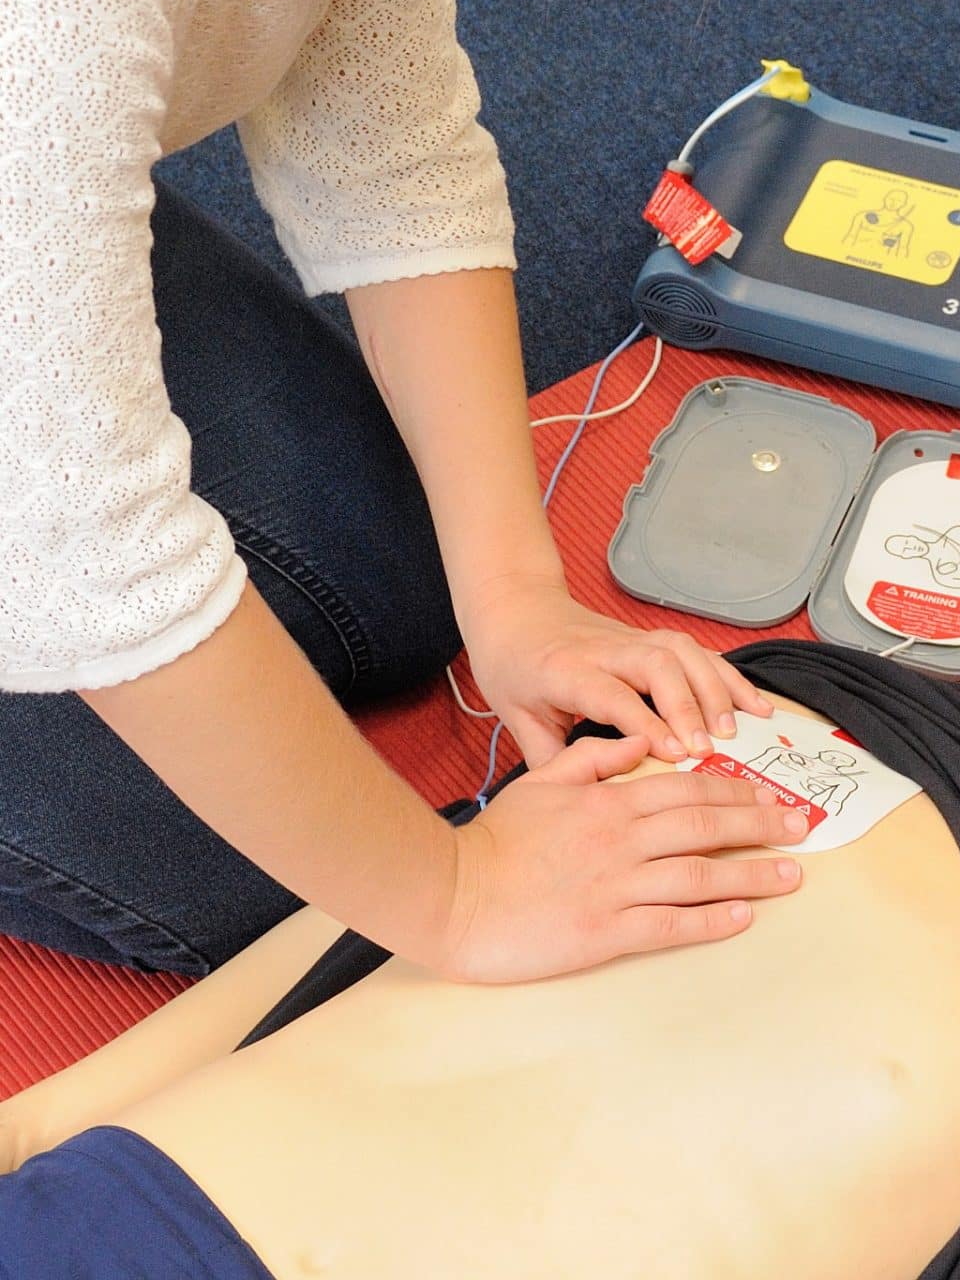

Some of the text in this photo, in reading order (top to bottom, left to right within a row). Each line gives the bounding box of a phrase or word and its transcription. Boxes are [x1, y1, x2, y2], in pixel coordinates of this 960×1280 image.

[942, 299, 960, 315] 3
[903, 590, 957, 608] TRAINING
[739, 768, 796, 805] TRAINING
